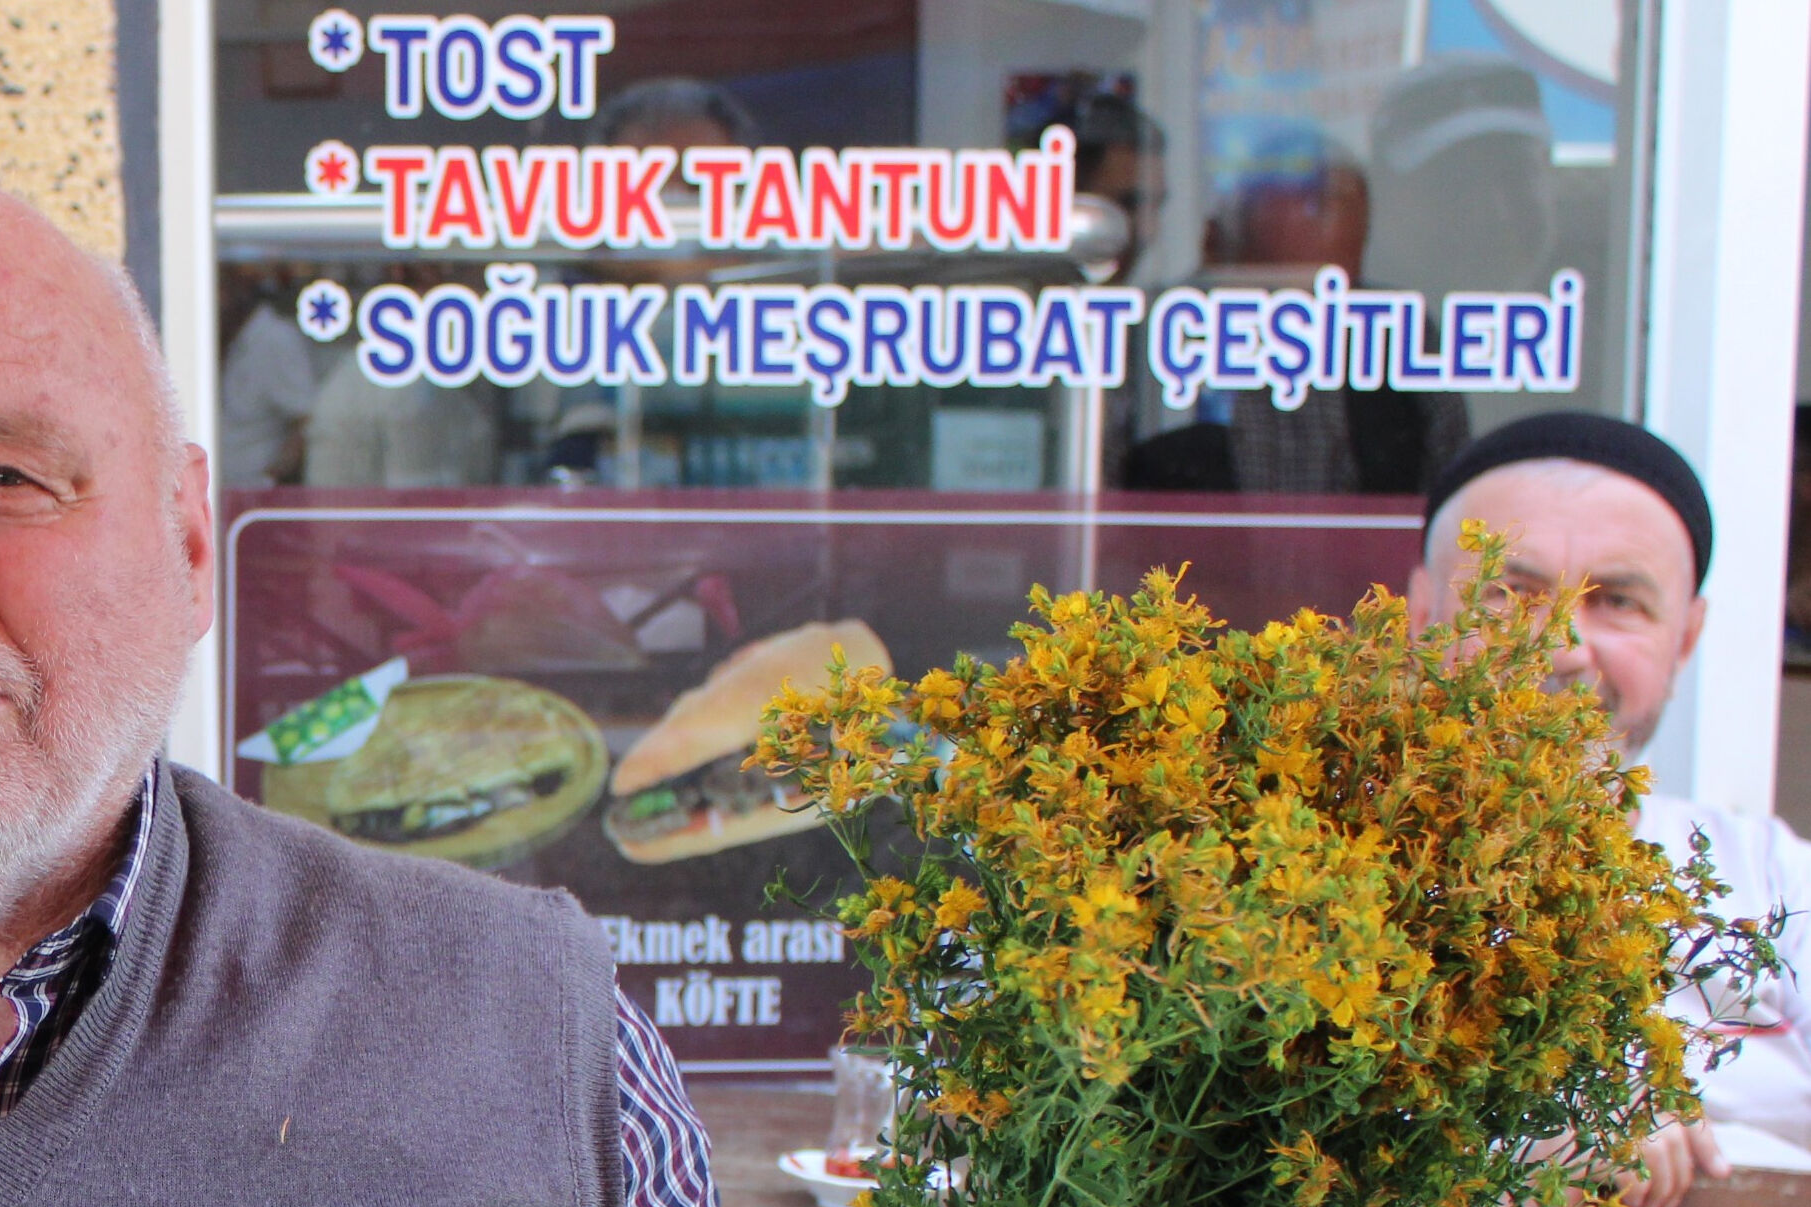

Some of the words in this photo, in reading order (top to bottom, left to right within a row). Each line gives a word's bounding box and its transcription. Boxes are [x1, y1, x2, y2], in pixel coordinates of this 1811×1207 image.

[378, 26, 603, 108] TOST
[374, 155, 668, 240] TAVUK
[692, 136, 1065, 241] TANTUNİ
[367, 268, 654, 377] SOĞUK
[681, 296, 1136, 398] MEŞRUBAT
[1156, 276, 1578, 398] ÇEŞİTLERİ
[655, 970, 782, 1027] KÖFTE
